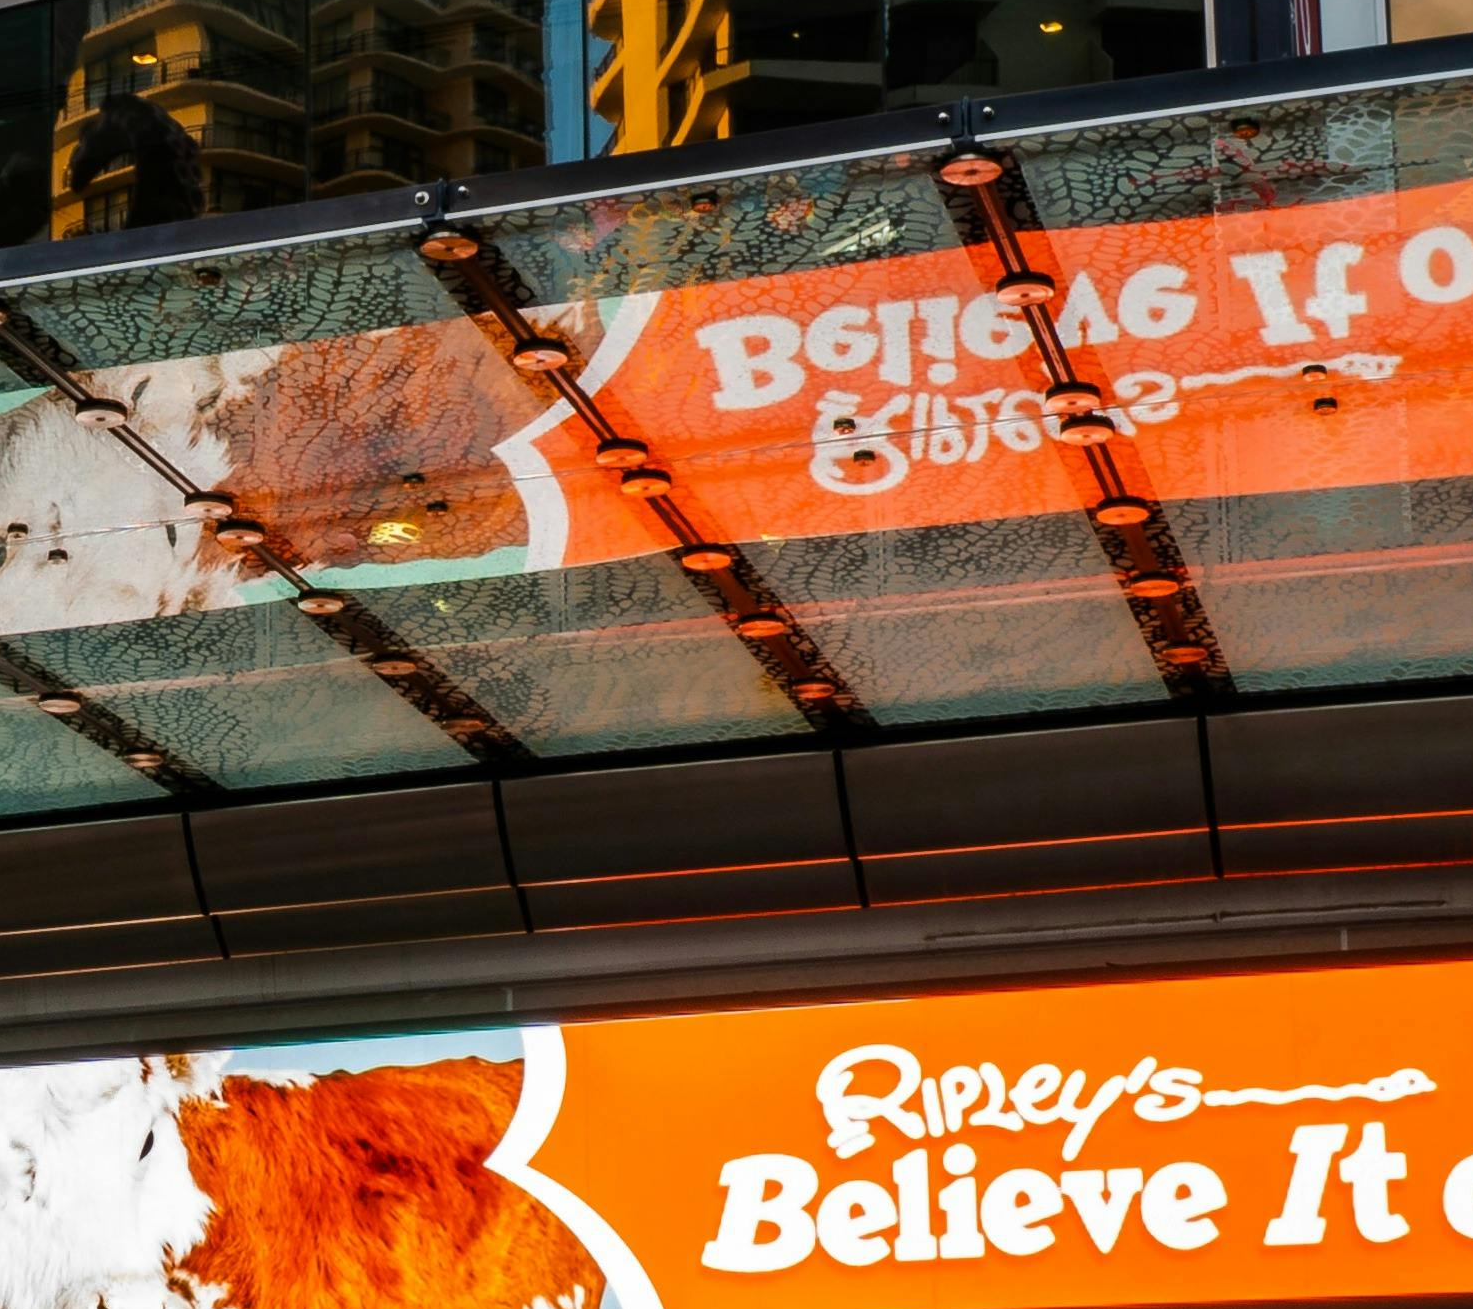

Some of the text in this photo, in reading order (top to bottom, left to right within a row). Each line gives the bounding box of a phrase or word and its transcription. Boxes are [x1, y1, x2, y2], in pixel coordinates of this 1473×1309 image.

[816, 1043, 1203, 1161] Ripley's
[701, 1143, 1228, 1275] Believe
[1263, 1122, 1409, 1246] It
